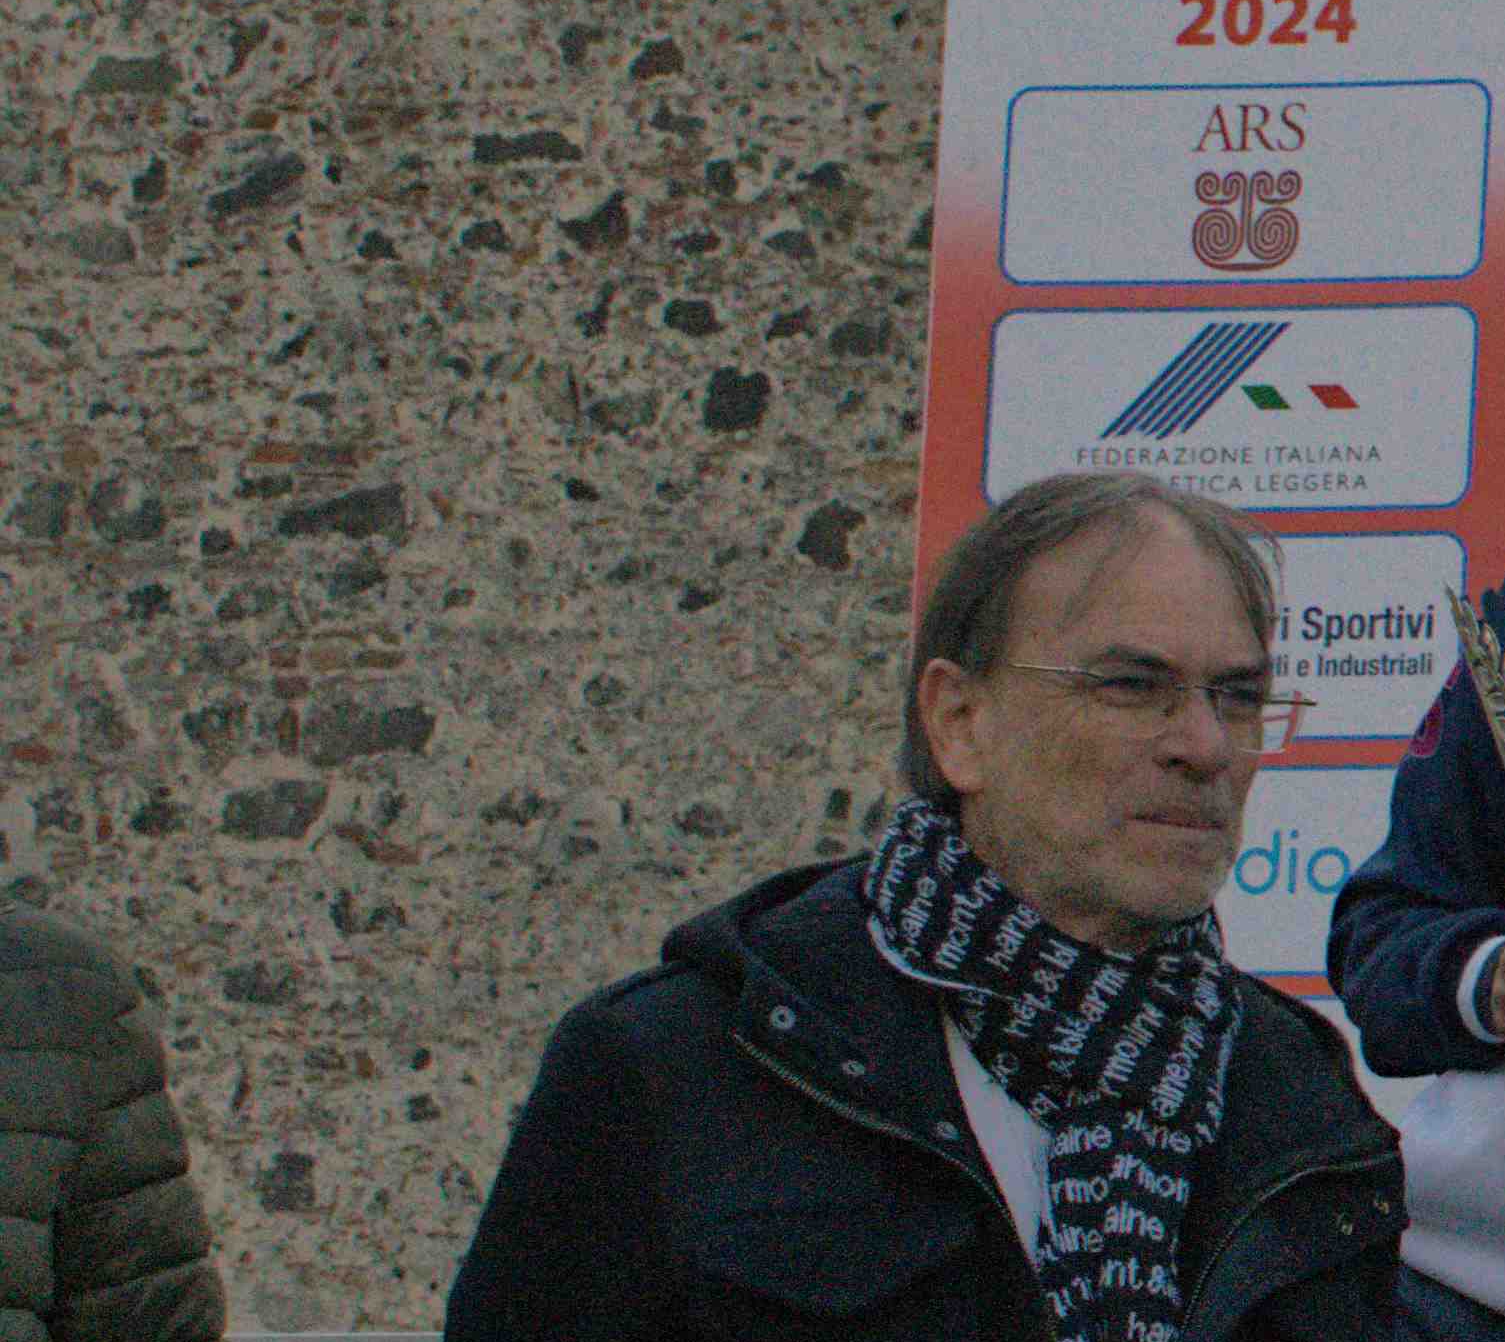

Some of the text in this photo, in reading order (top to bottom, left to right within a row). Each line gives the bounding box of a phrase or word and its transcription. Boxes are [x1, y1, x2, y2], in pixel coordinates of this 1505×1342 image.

[1195, 105, 1306, 153] ARS
[1076, 445, 1382, 467] FEDERAZIONE ITALIANA
[1169, 474, 1368, 493] ETICA LEGGERA
[1301, 605, 1434, 648] Sportivi
[1315, 652, 1433, 677] Industriali
